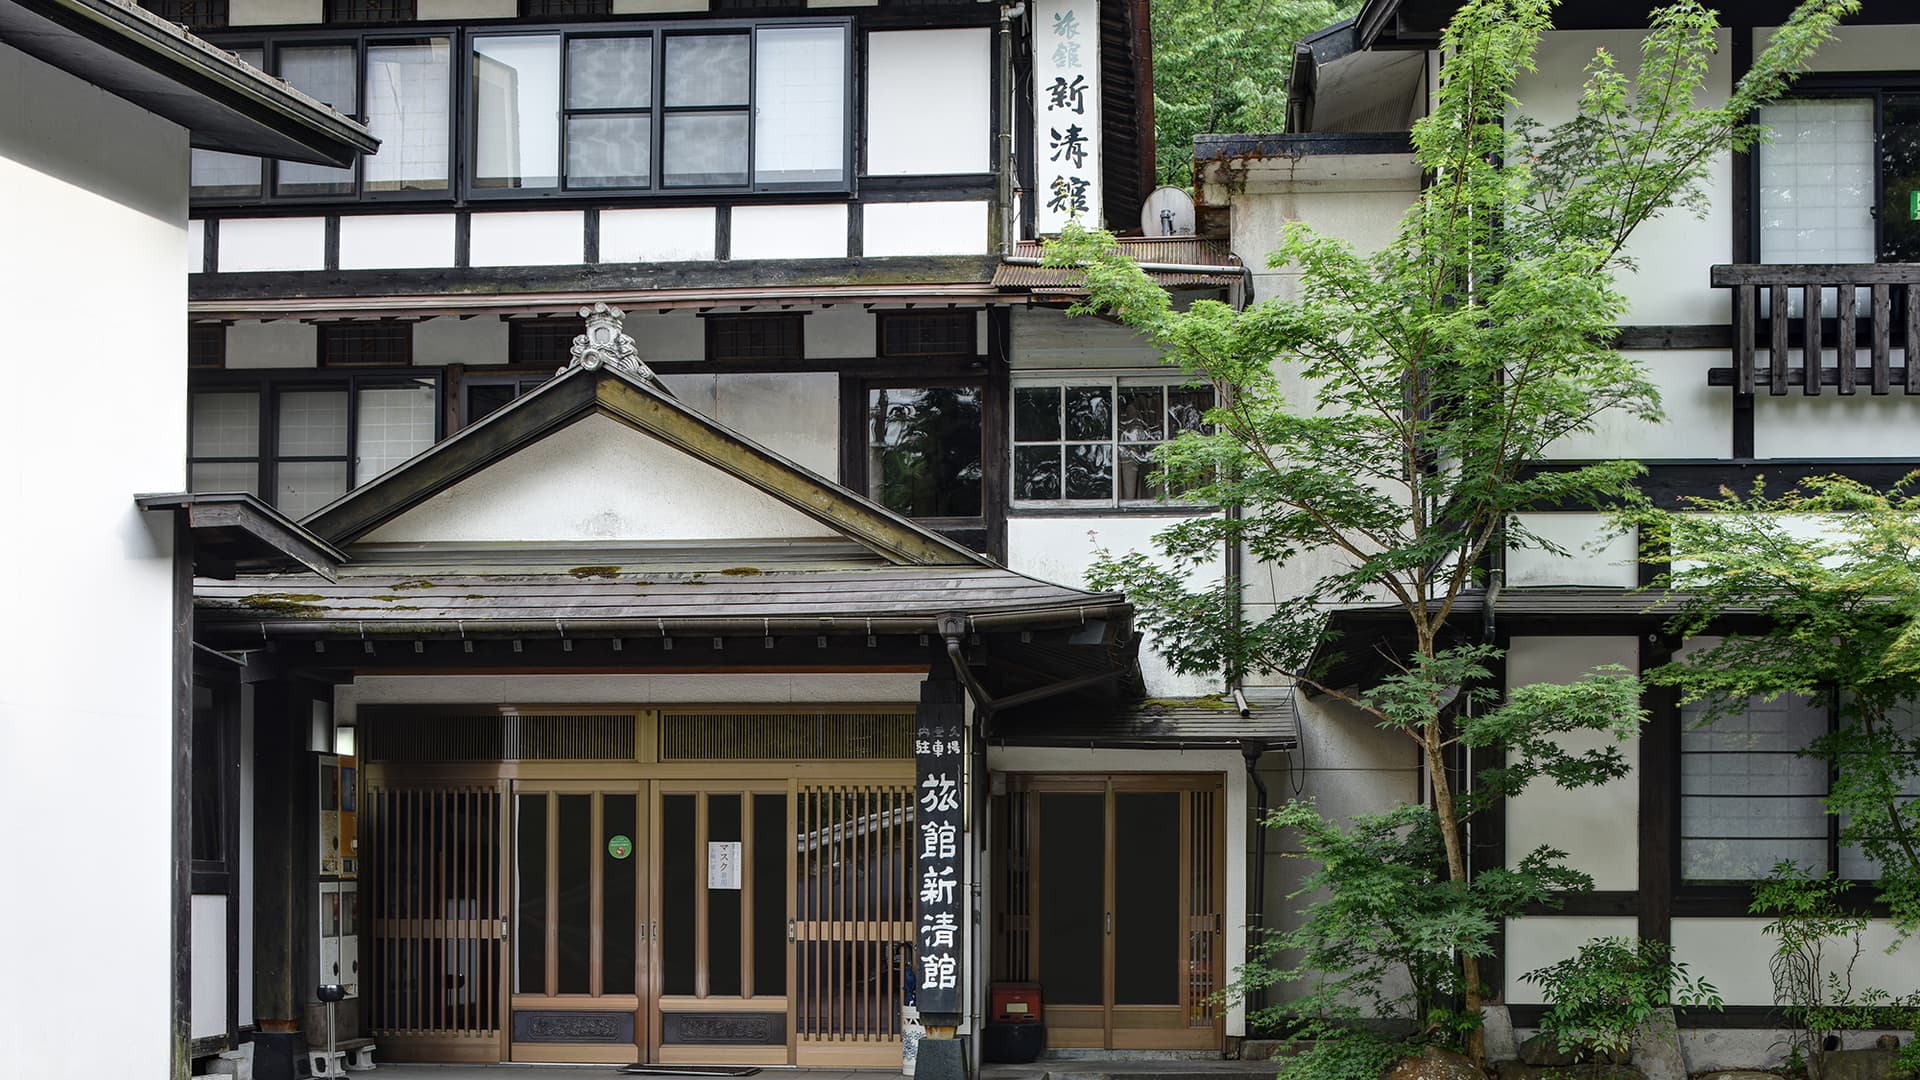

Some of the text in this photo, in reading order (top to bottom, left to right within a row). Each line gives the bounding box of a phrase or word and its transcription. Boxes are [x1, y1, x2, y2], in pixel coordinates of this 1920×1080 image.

[916, 740, 961, 757] 駐車場
[920, 773, 958, 990] 旅館新清館
